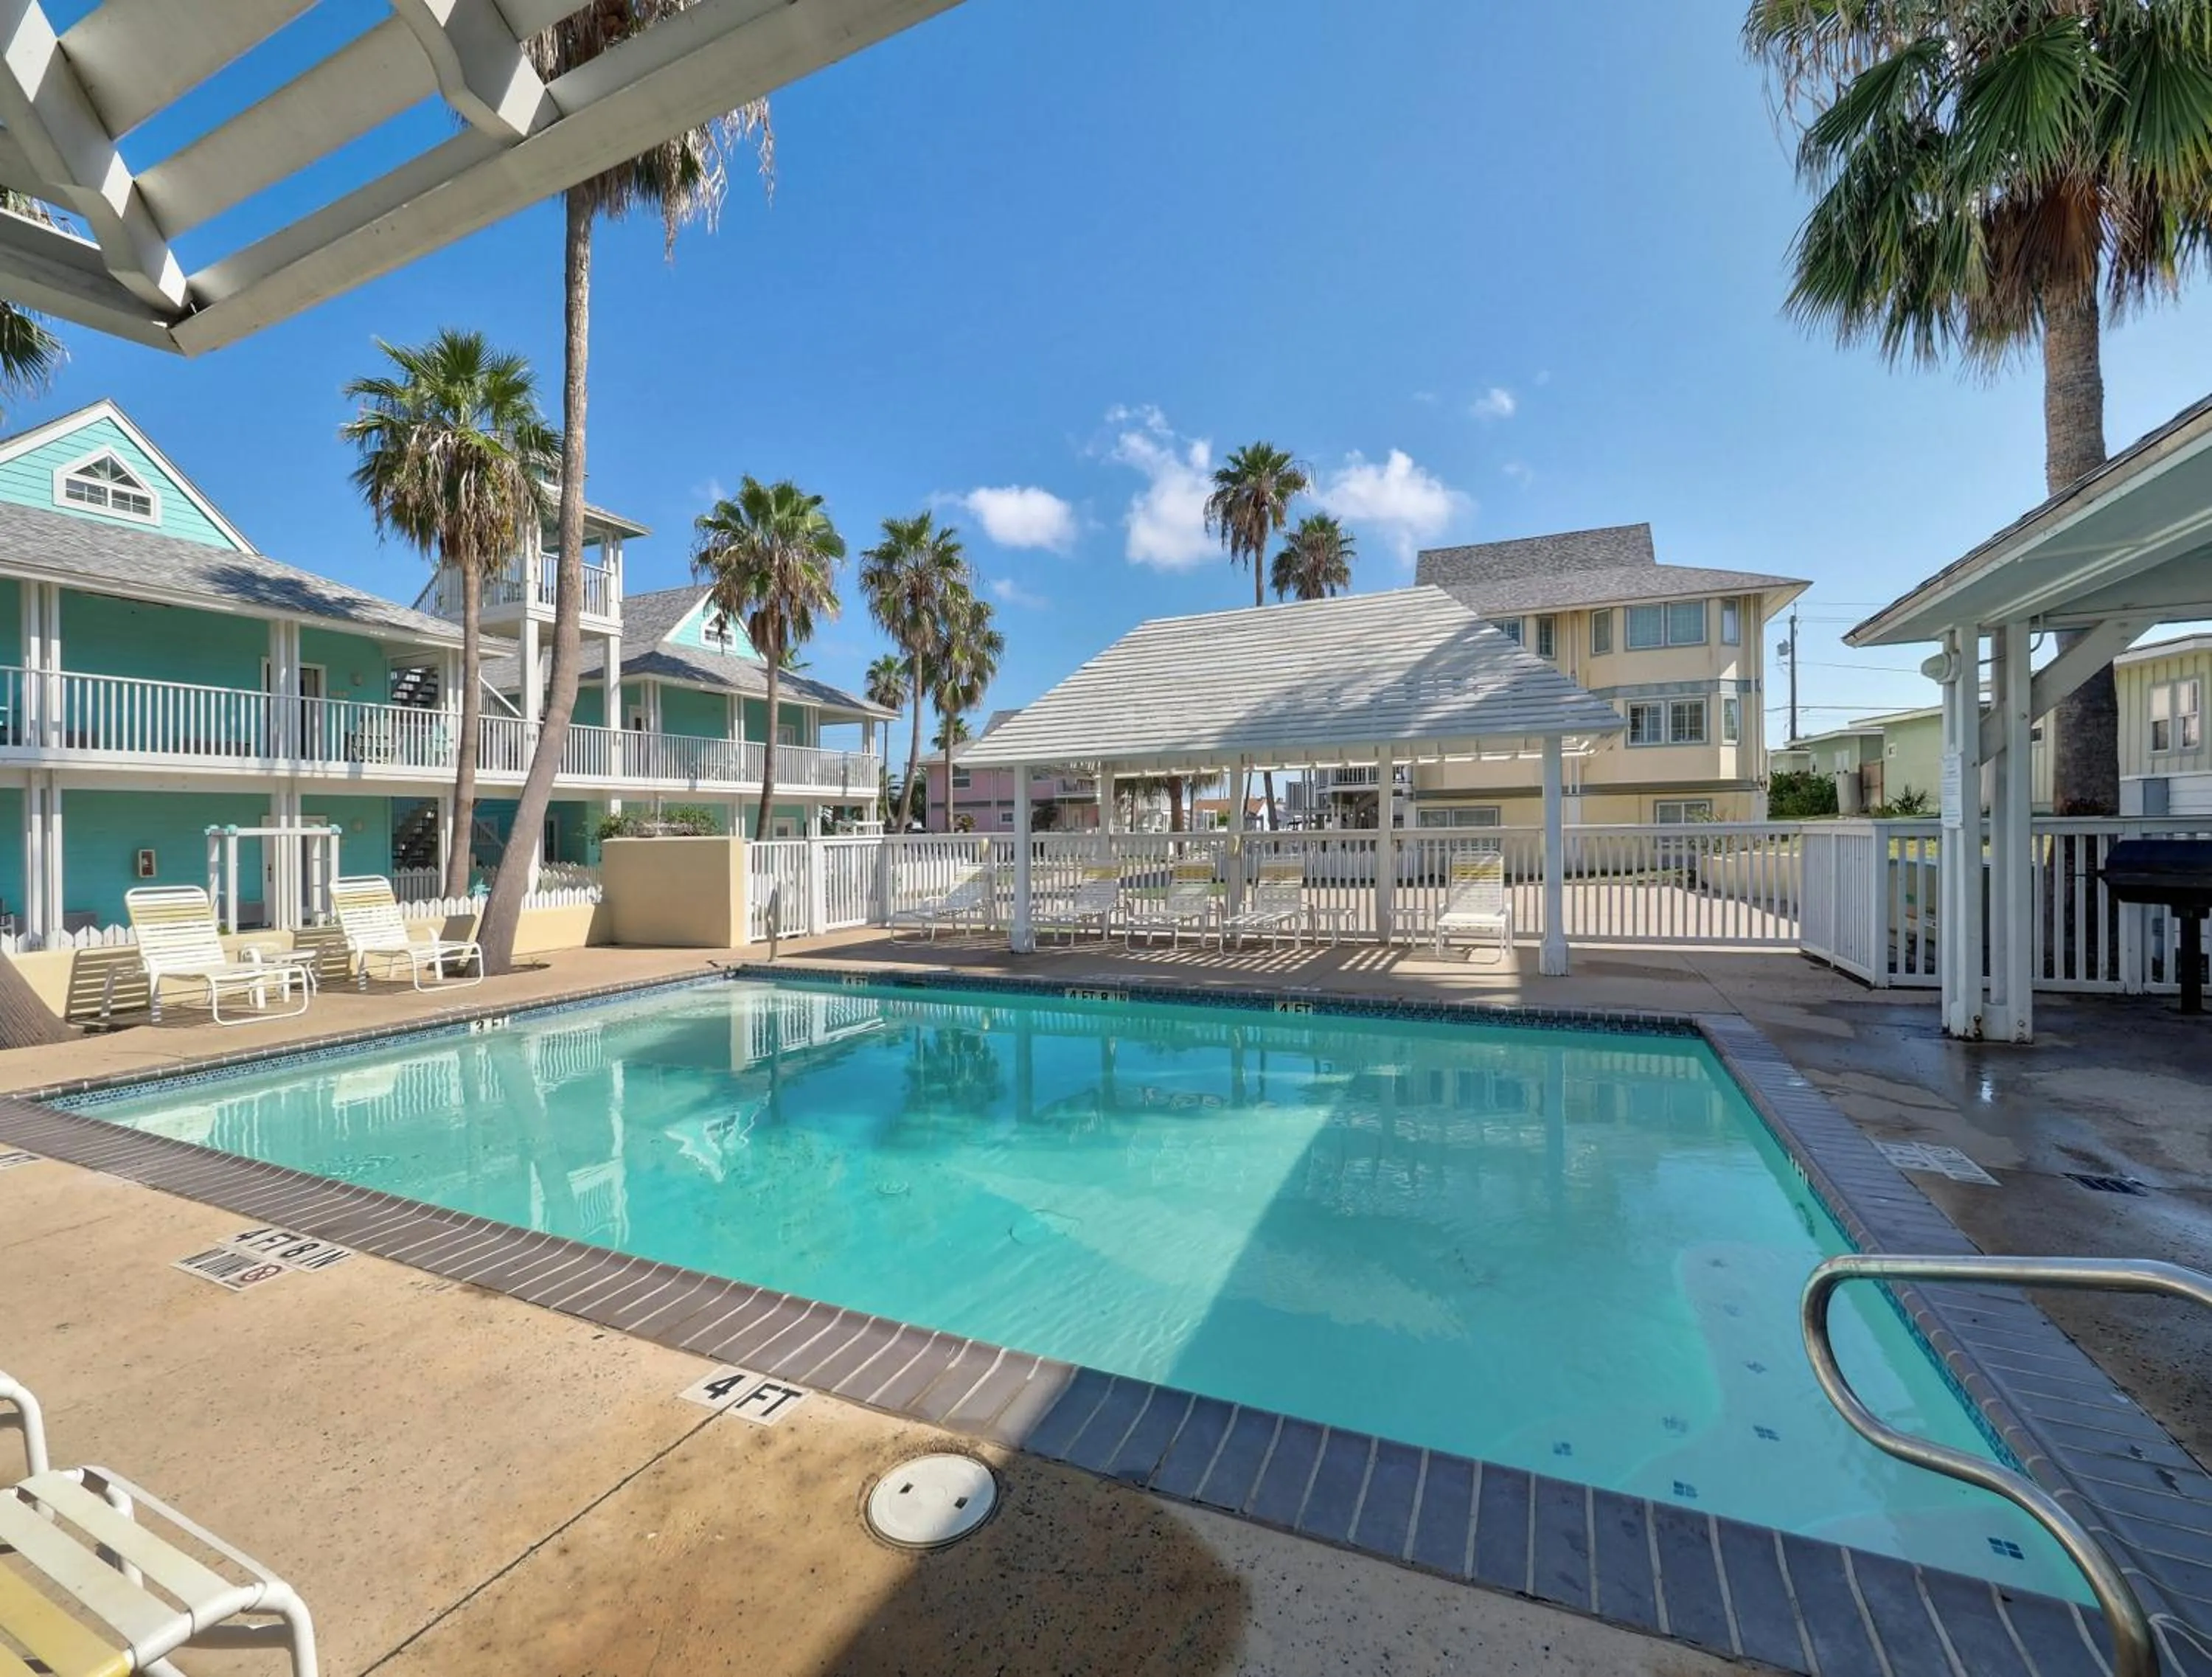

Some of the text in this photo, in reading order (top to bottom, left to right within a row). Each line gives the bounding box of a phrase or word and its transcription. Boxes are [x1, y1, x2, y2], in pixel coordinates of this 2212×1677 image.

[1082, 990, 1094, 1000] FT
[1295, 1004, 1311, 1013] FT
[235, 1228, 272, 1242] 4
[279, 1243, 321, 1258] 8
[299, 1249, 352, 1269] IN
[703, 1374, 803, 1417] 4 FT
